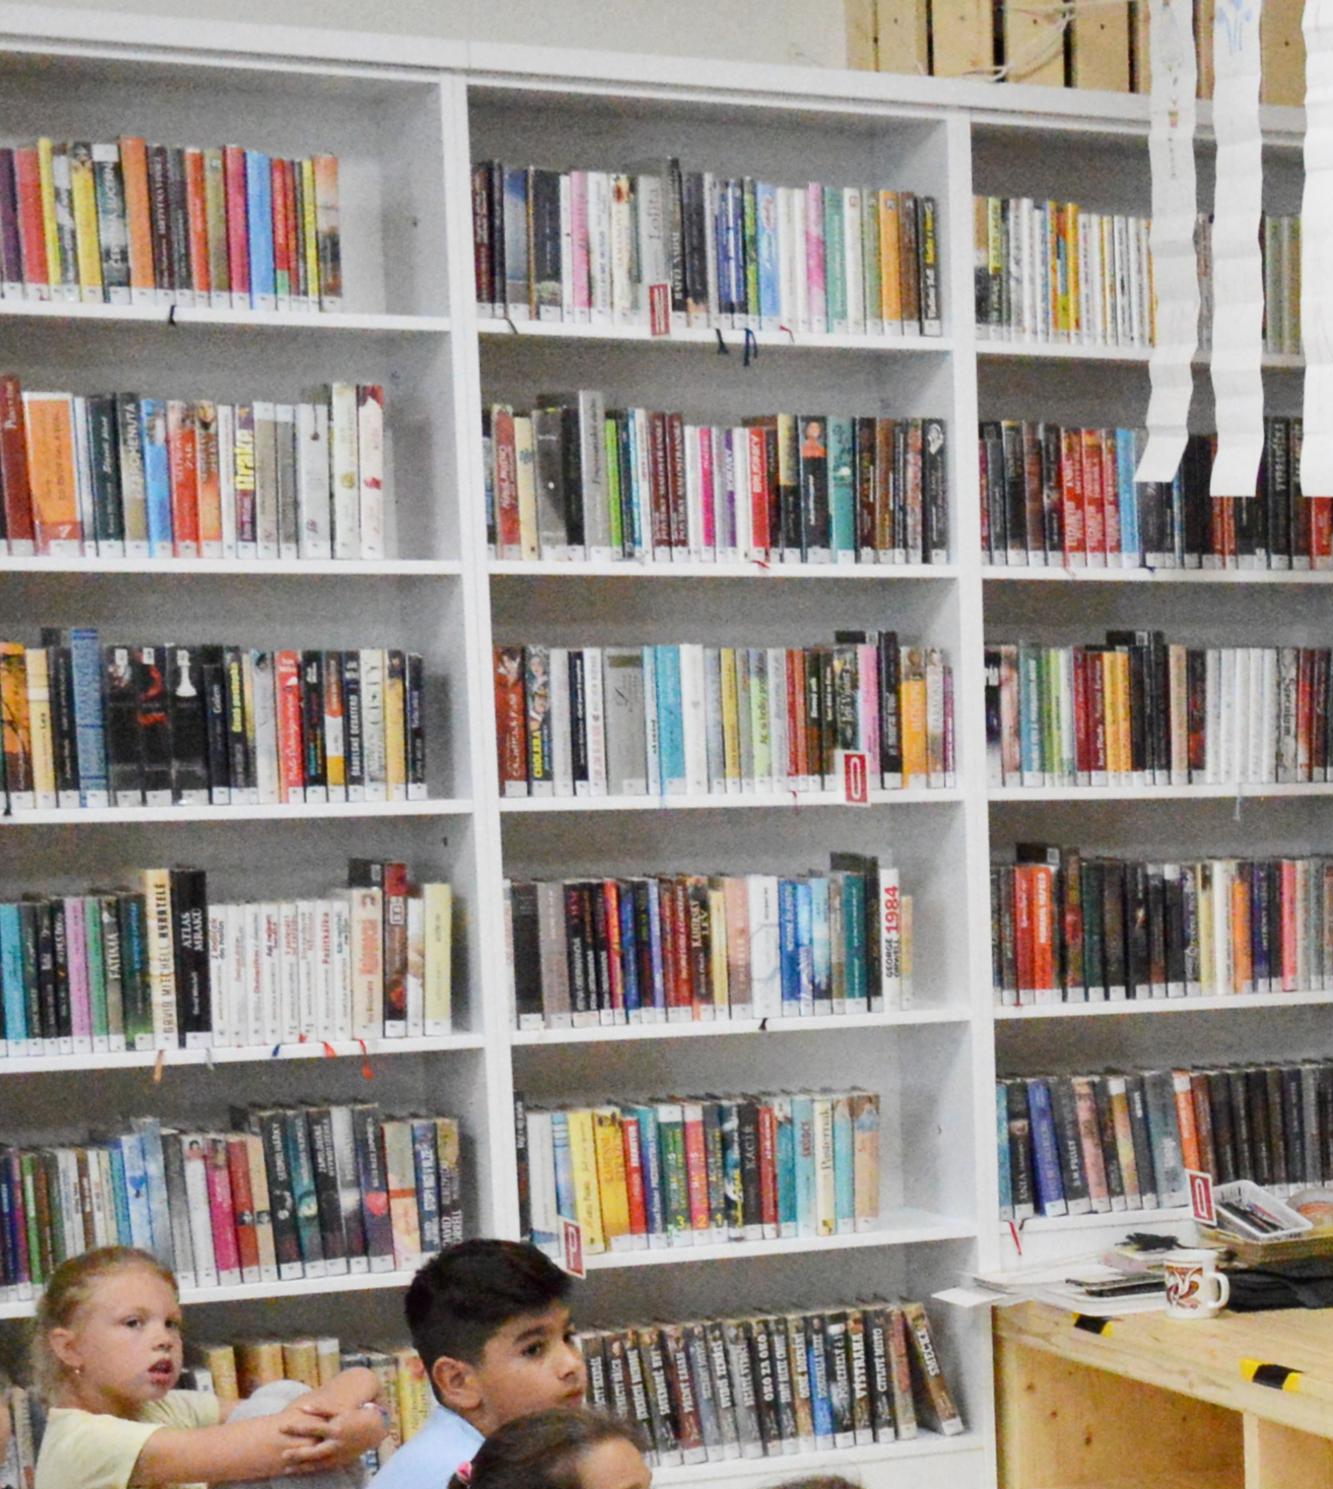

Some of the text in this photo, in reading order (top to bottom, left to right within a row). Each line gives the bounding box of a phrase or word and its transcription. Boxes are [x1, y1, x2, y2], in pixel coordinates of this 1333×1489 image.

[850, 756, 862, 800] O
[883, 886, 900, 934] 1984
[1195, 1178, 1209, 1219] O
[567, 1227, 578, 1271] P
